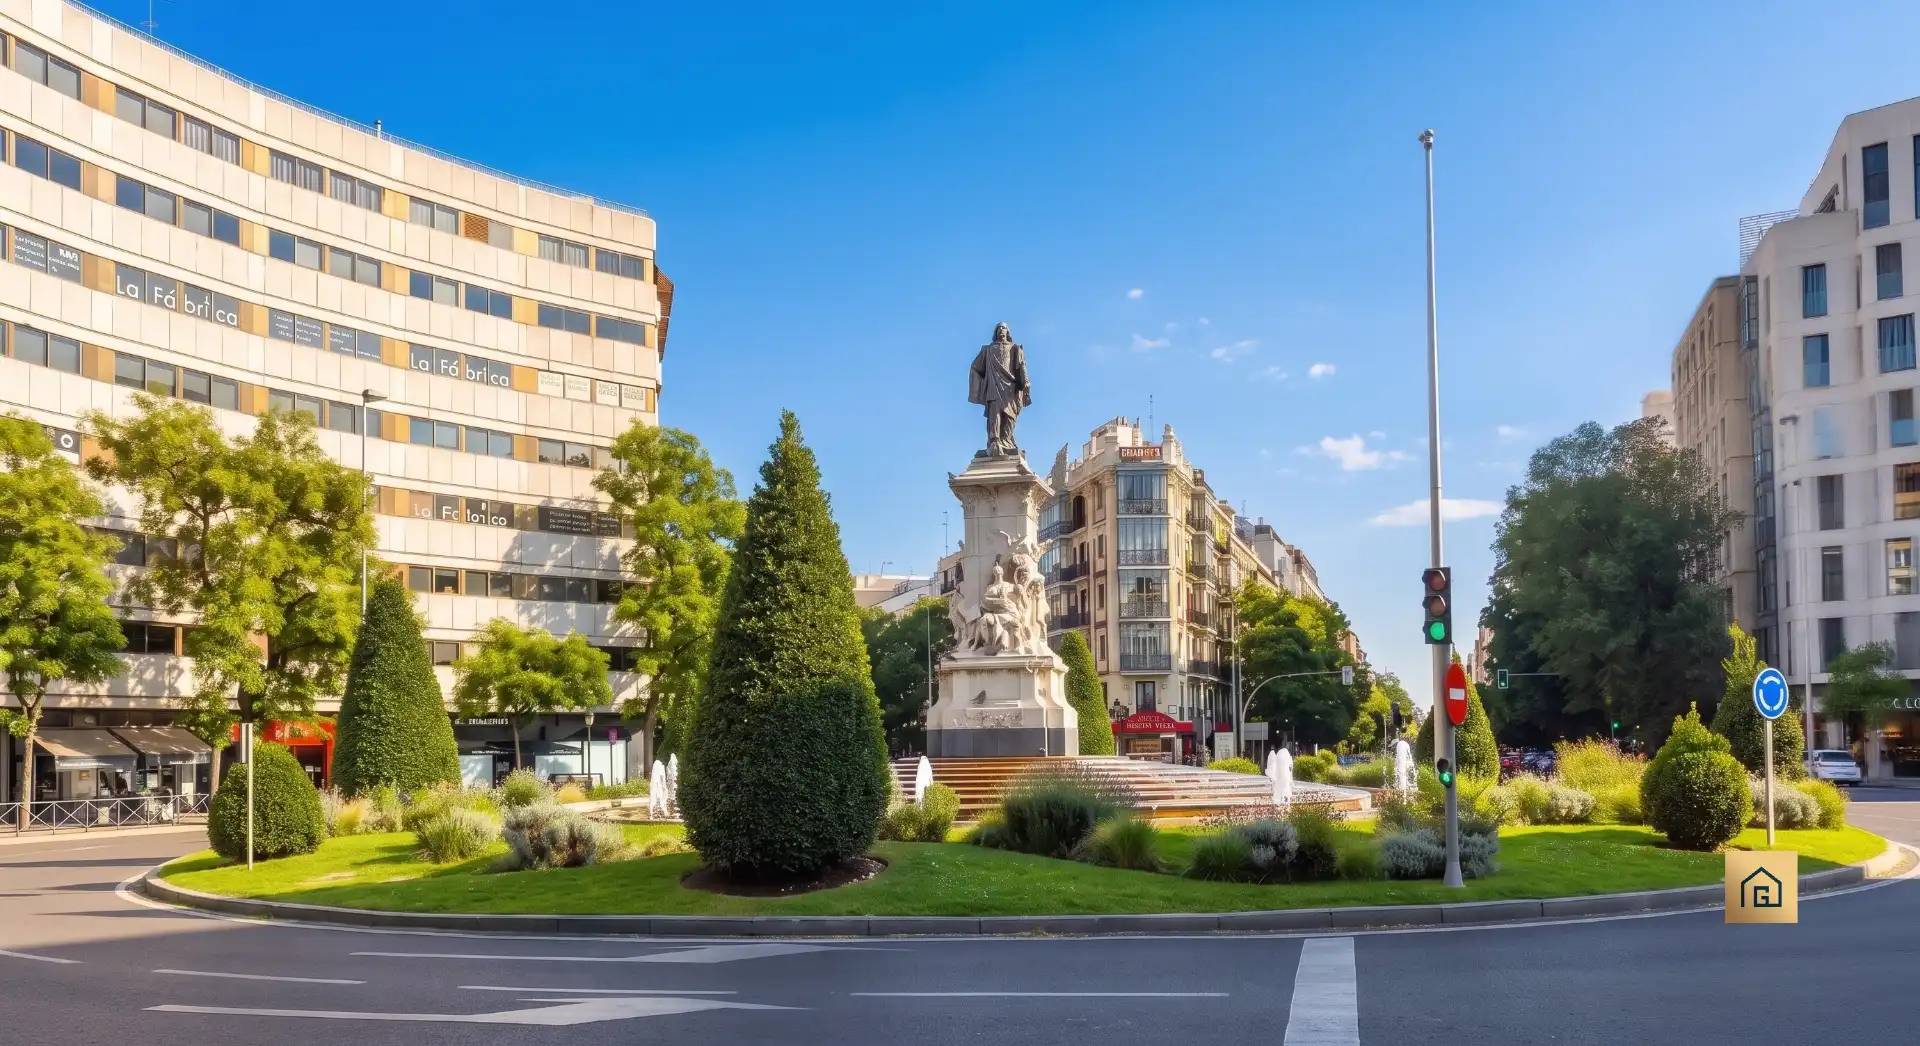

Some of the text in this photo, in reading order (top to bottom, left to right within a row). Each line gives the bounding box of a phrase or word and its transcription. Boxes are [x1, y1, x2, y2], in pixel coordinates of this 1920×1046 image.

[116, 274, 239, 326] La Fábrica
[410, 352, 429, 372] La
[440, 358, 509, 387] Fábrica
